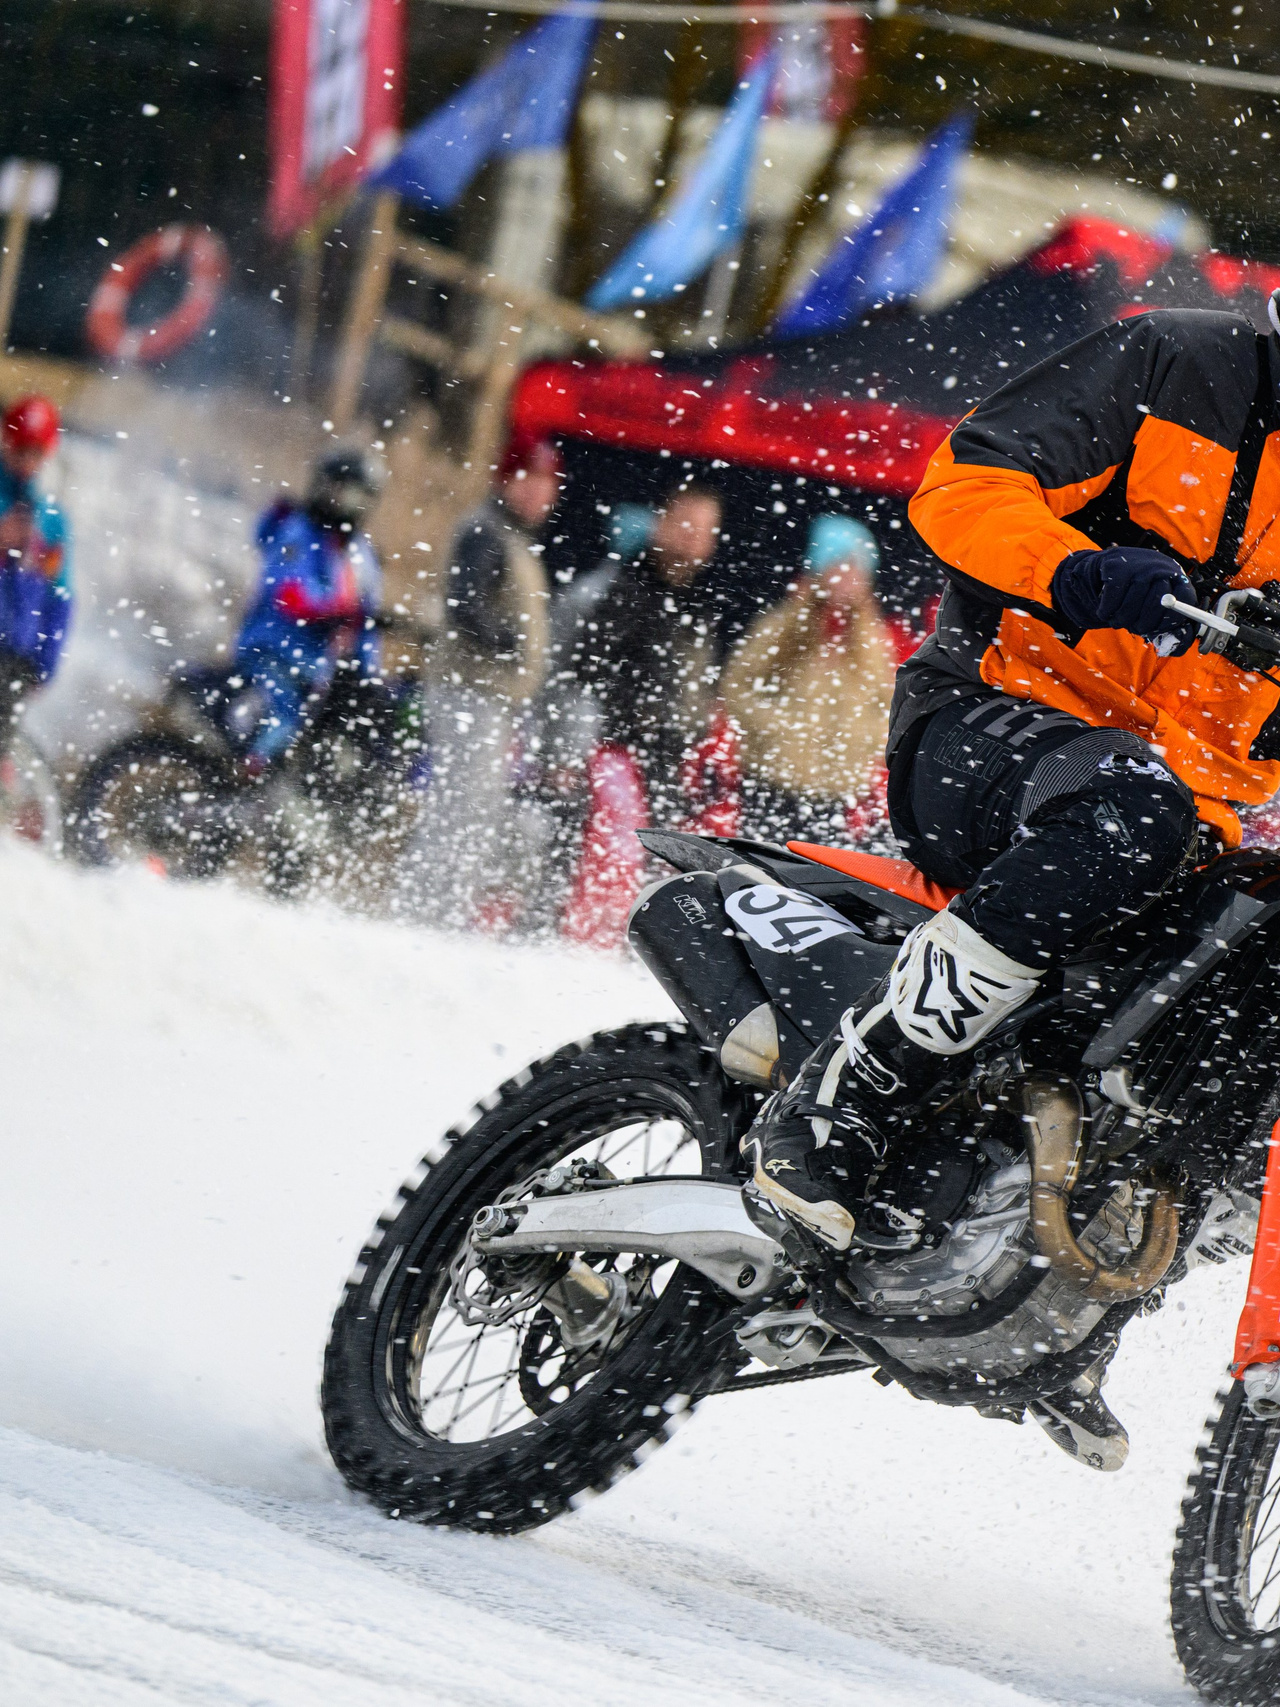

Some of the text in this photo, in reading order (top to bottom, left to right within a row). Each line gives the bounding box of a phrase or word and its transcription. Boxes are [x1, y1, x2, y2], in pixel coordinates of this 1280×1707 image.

[932, 723, 1014, 783] RACING
[673, 894, 707, 924] KTM
[738, 888, 852, 948] 34
